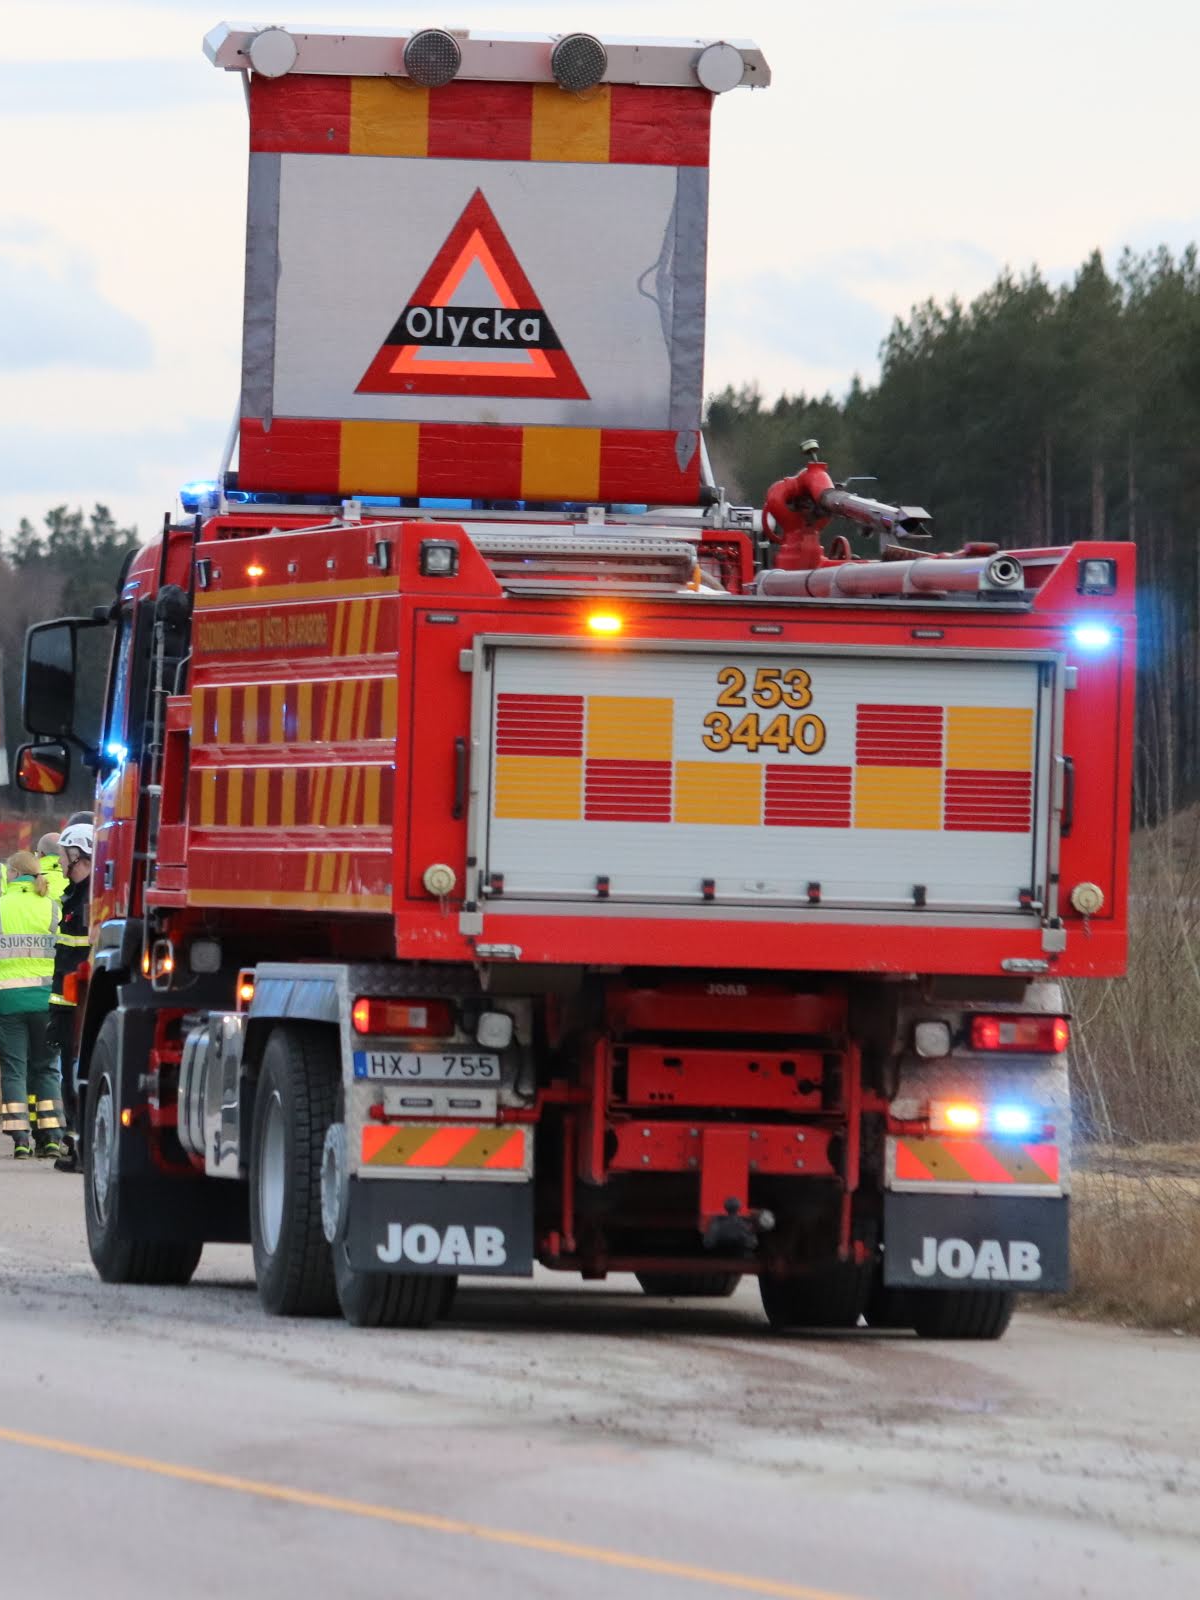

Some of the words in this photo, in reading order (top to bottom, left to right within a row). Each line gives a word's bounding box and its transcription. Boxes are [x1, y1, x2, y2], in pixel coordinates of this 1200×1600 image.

[406, 306, 541, 347] Olycka
[702, 711, 827, 756] 3440
[706, 984, 748, 996] JOAB
[371, 1055, 422, 1076] HXJ
[442, 1056, 494, 1077] 755
[376, 1222, 507, 1266] JOAB
[910, 1236, 1042, 1281] JOAB
